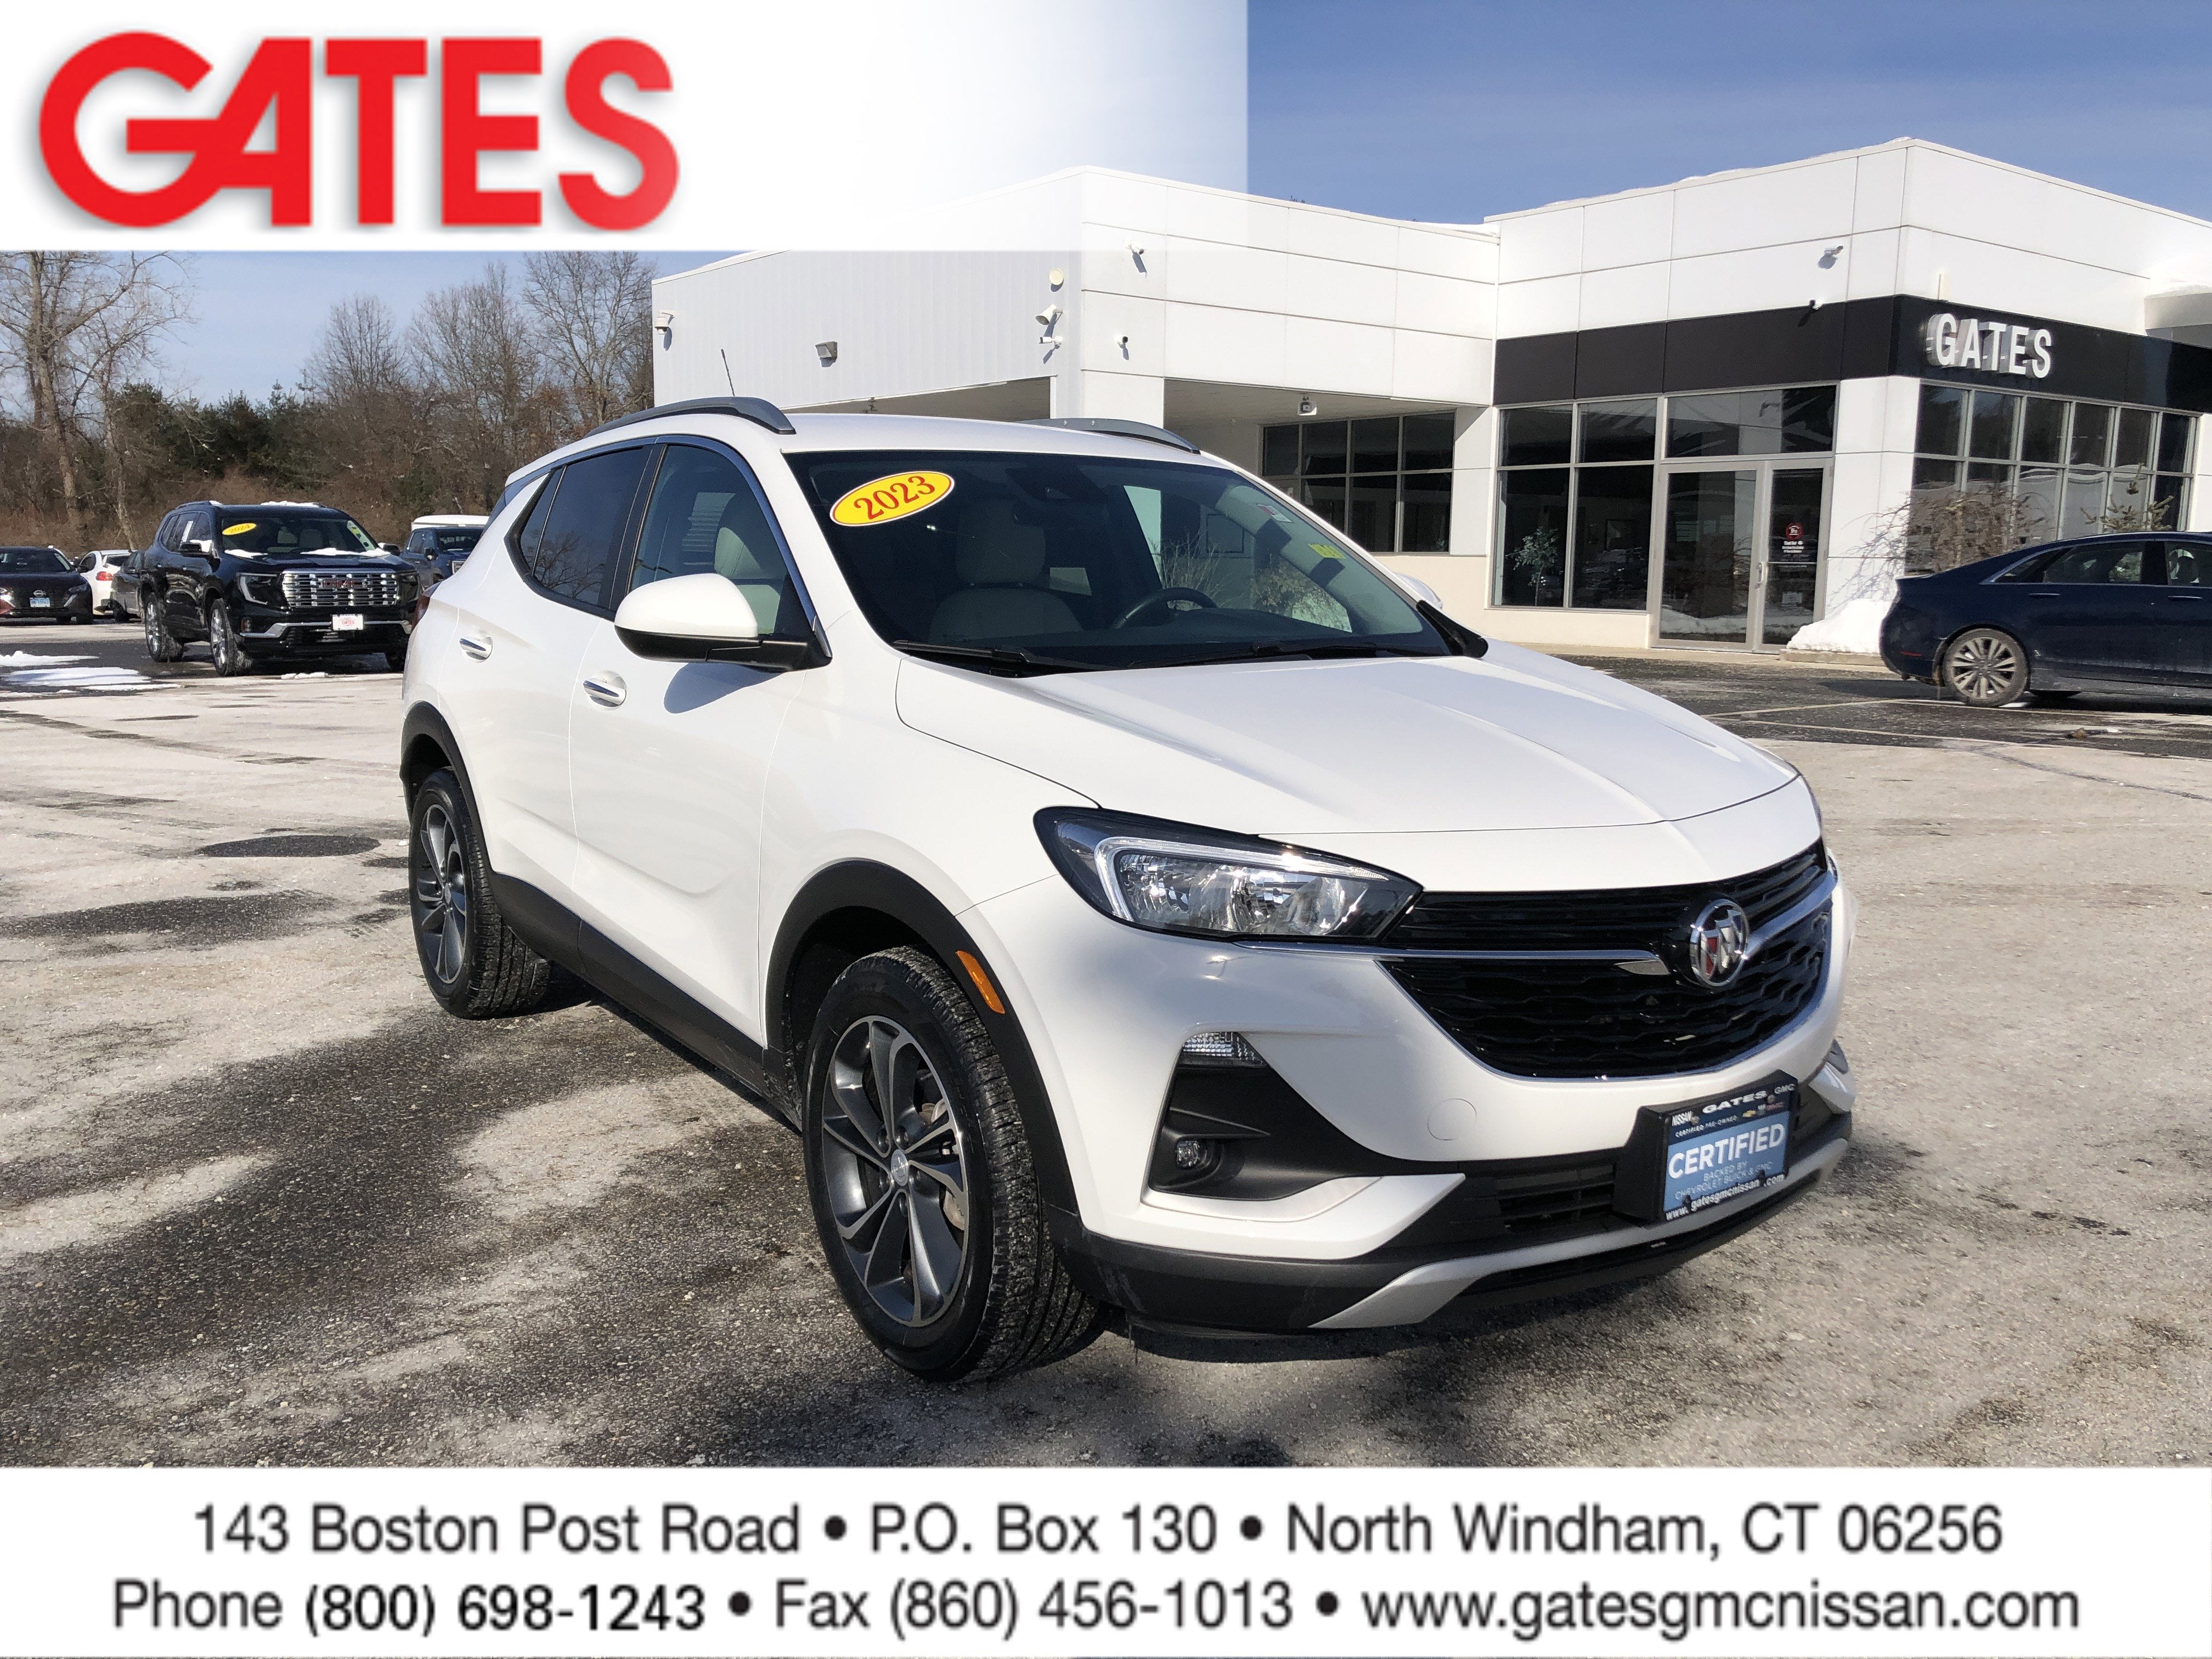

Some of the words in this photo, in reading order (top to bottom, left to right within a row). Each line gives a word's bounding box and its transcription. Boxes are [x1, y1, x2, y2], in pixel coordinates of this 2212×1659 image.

[1930, 313, 2052, 379] GATES
[854, 476, 935, 520] 2023
[1702, 1091, 1768, 1114] GATES
[1774, 1084, 1795, 1094] GMC
[1668, 1123, 1786, 1179] CERTIFIED
[1675, 1180, 1721, 1200] CHEVROLET
[1724, 1171, 1747, 1184] BUICK
[1703, 1164, 1735, 1182] BACKED
[1737, 1161, 1747, 1171] BY
